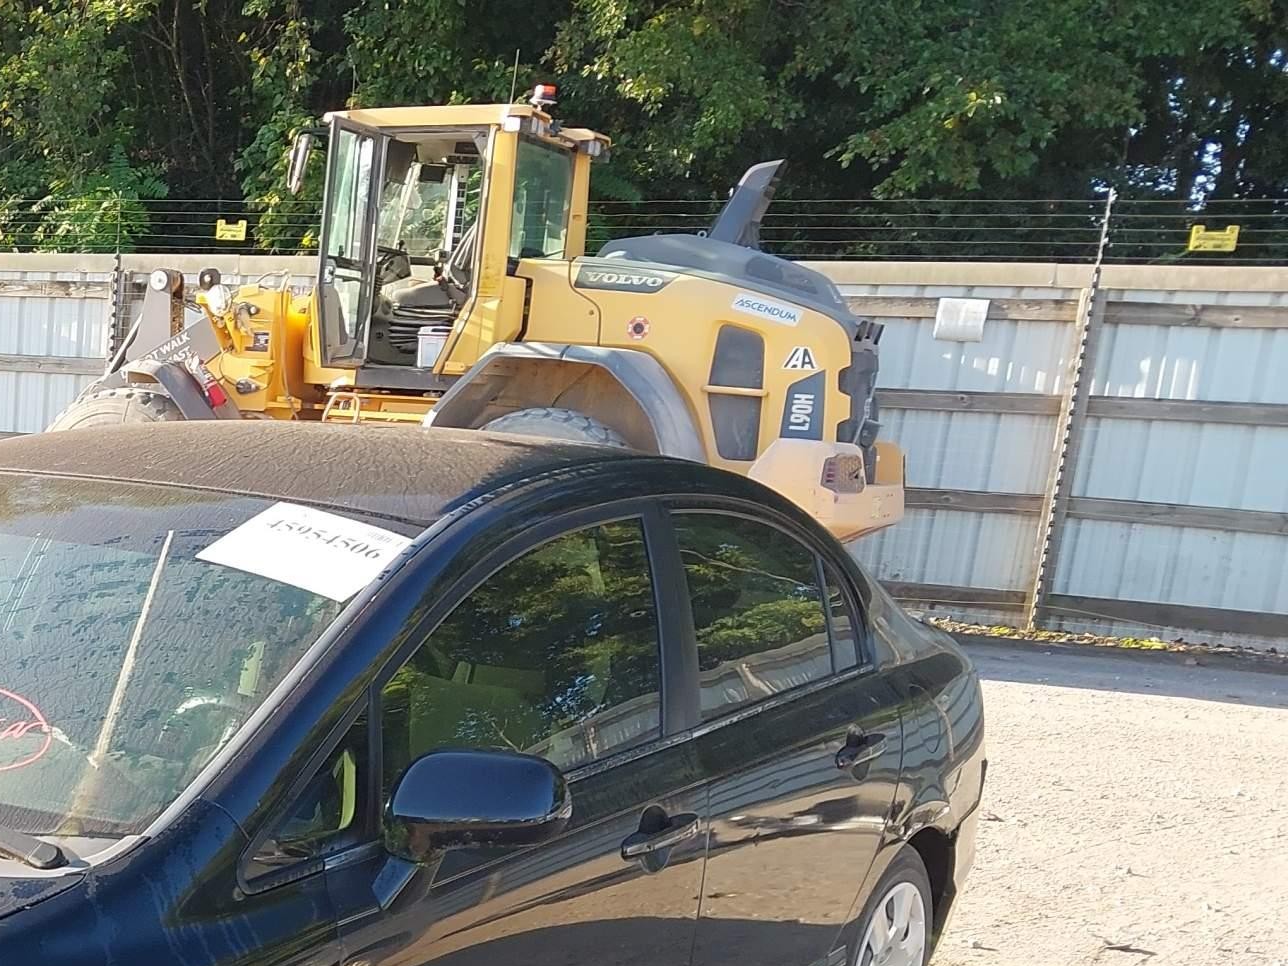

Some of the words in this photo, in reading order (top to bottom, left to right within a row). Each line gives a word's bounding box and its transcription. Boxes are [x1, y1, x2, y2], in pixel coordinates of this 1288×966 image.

[585, 271, 664, 287] VOLVO
[735, 299, 797, 322] ASCENDUM
[158, 331, 191, 355] WALK
[788, 393, 815, 431] L90H
